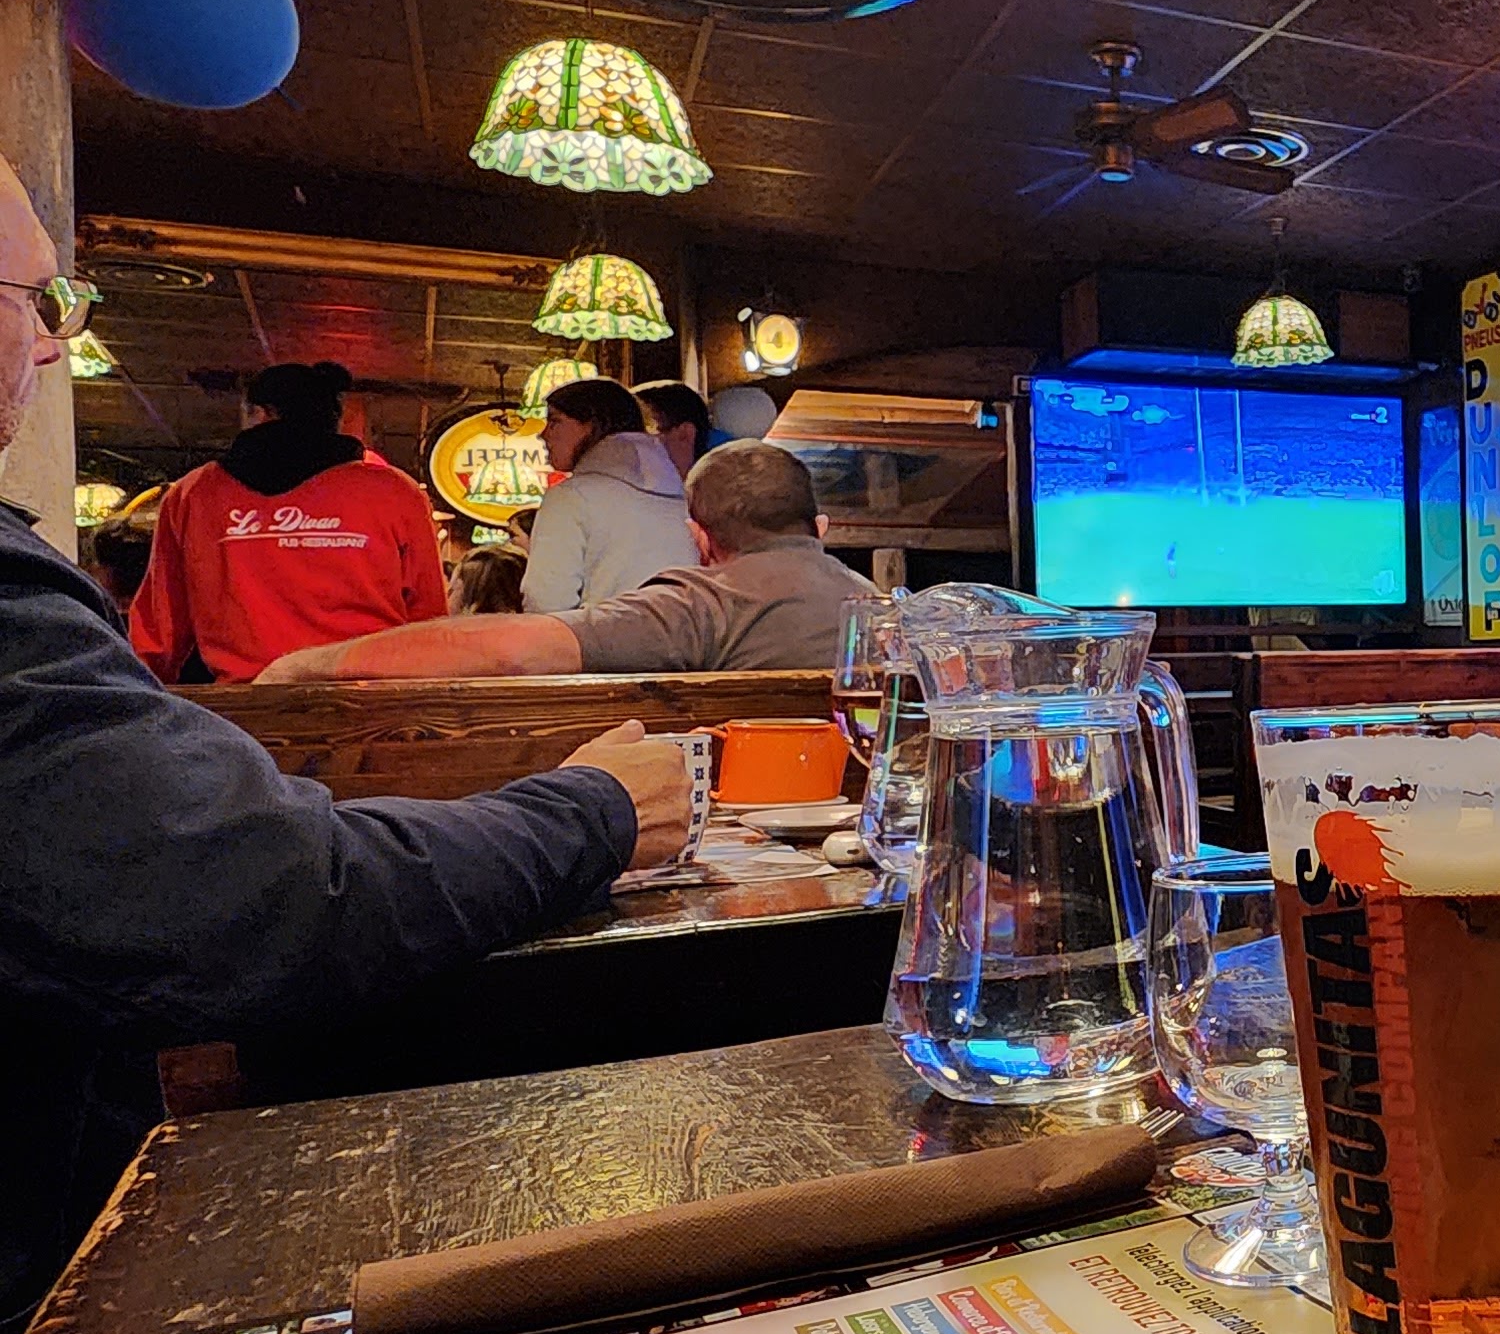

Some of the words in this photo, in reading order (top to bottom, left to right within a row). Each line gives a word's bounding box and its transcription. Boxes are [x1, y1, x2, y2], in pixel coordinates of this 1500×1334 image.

[226, 508, 263, 535] Le
[268, 505, 342, 532] Divan
[1069, 1254, 1112, 1272] ET
[1126, 1242, 1197, 1294] Téléchargez
[1084, 1264, 1178, 1329] RETROUVEZ
